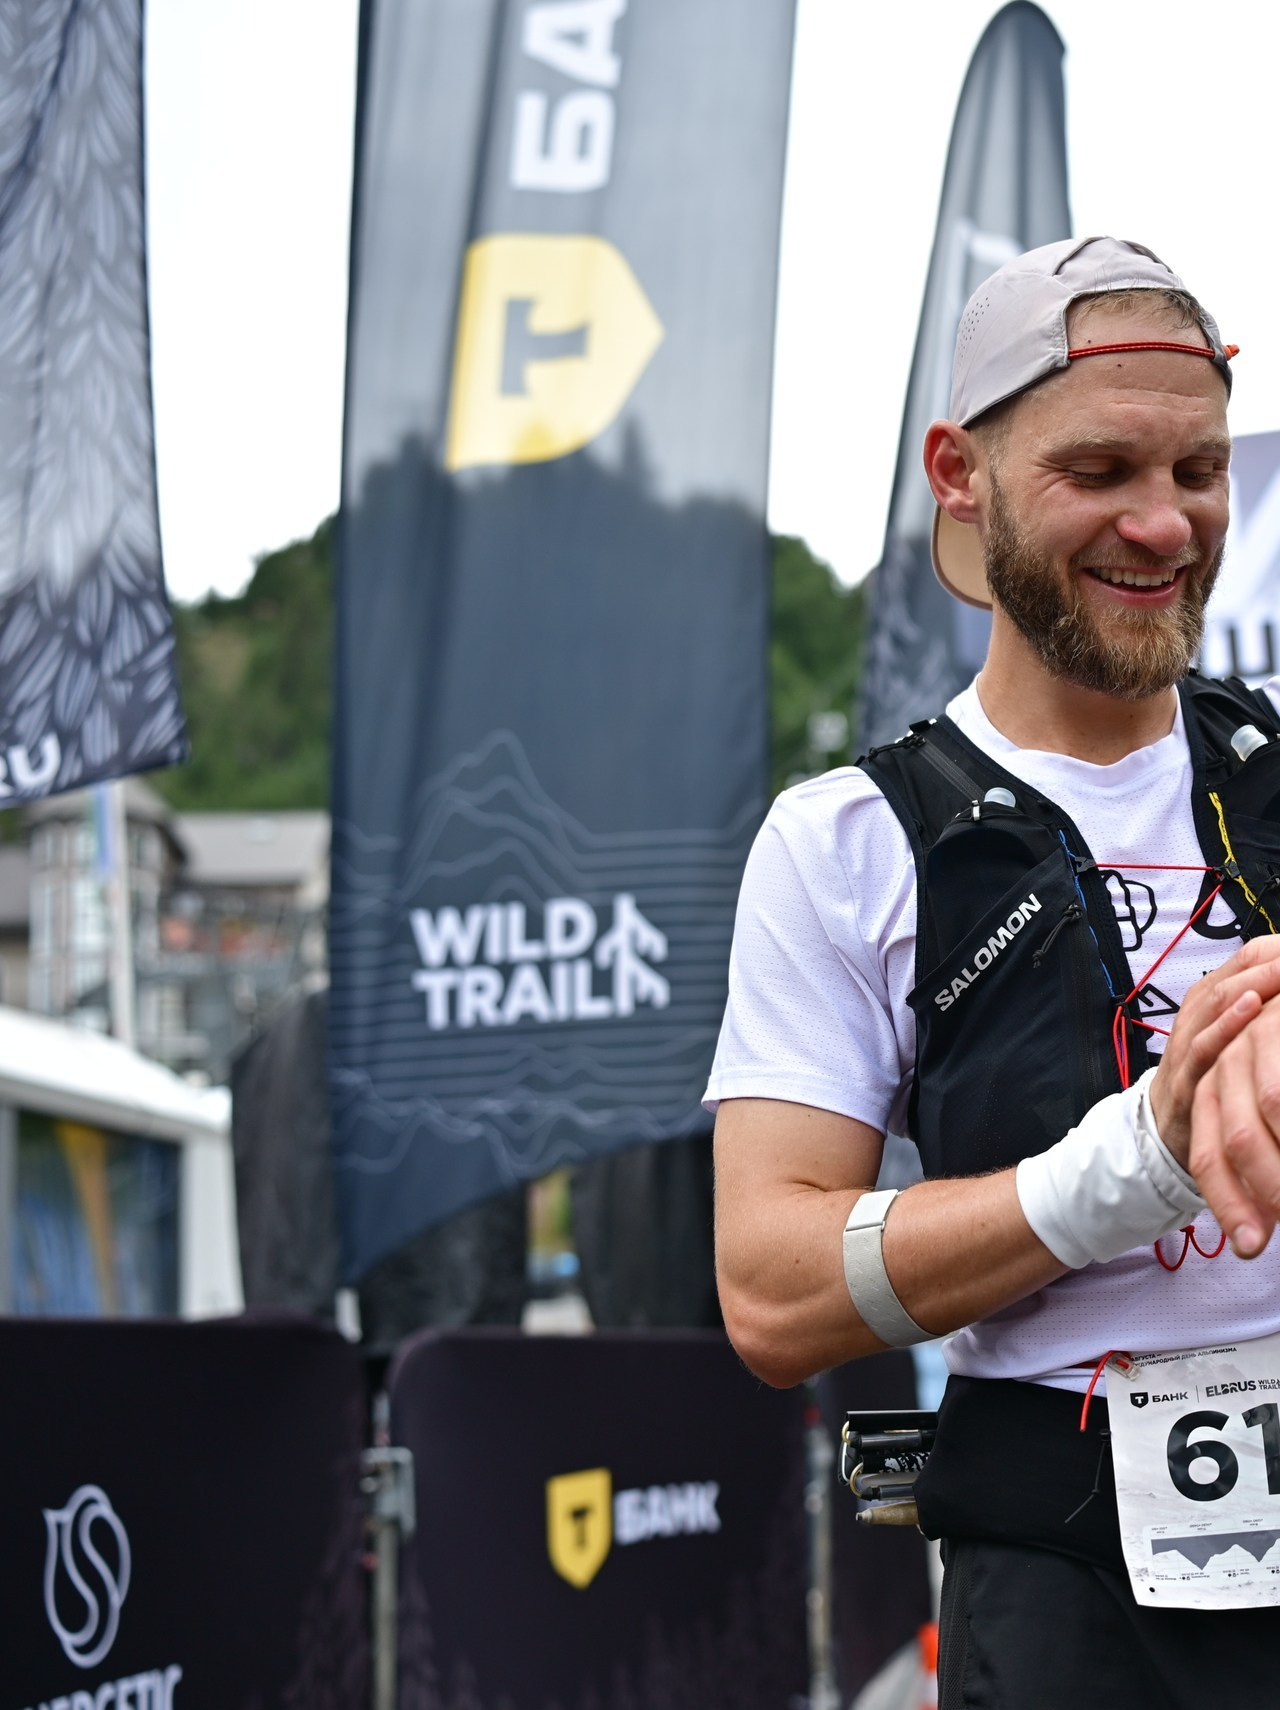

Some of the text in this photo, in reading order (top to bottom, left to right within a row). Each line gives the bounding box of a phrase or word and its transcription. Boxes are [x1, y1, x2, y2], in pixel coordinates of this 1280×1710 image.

[411, 898, 598, 967] WILD
[934, 893, 1042, 1012] SALOMON
[411, 957, 613, 1030] TRAIL
[1152, 1392, 1189, 1403] БАНК
[1205, 1380, 1257, 1397] ELBRUS
